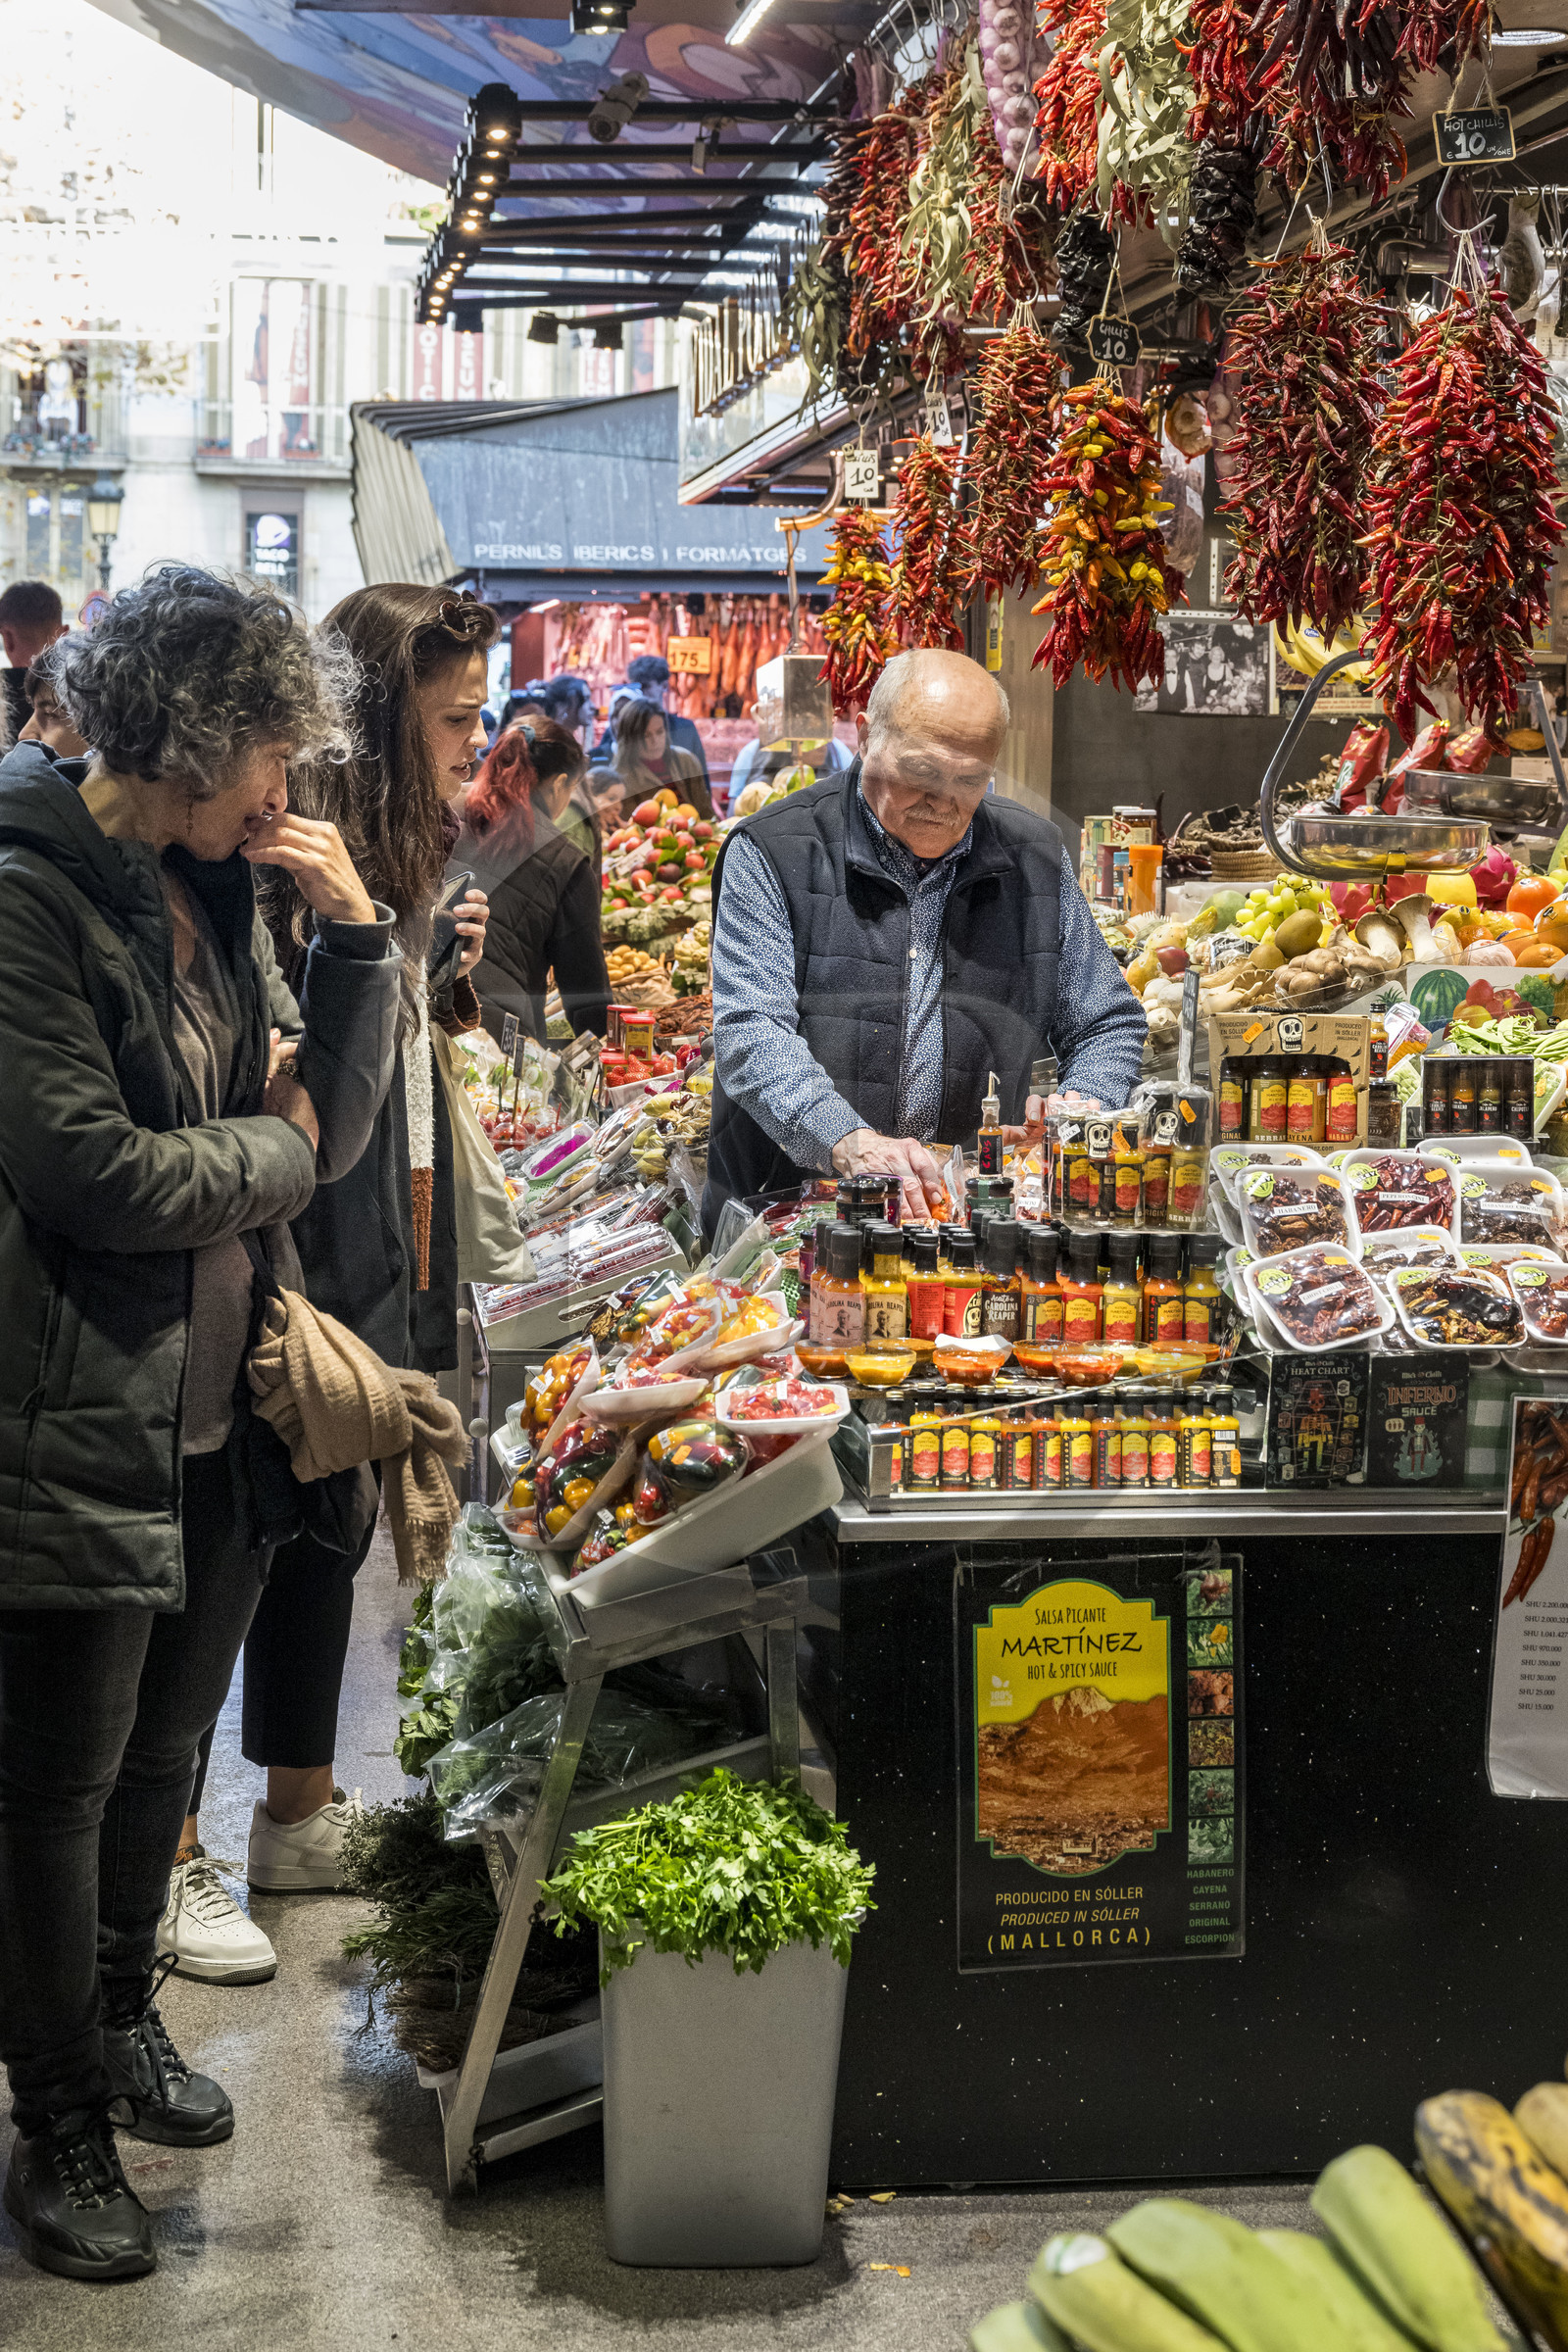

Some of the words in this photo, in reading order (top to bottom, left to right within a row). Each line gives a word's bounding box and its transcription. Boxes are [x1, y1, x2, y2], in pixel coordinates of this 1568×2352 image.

[1444, 118, 1467, 132] HOT
[1454, 132, 1487, 159] 10
[1102, 337, 1126, 360] 10
[930, 411, 946, 434] 10
[850, 467, 874, 487] 10
[573, 545, 655, 562] IBERICS
[676, 546, 808, 564] FORMATGES
[1278, 1204, 1316, 1214] HABANERO
[985, 1300, 1018, 1311] CAROLINA
[987, 1311, 1015, 1321] REAPER
[1388, 1385, 1457, 1406] INFERNO
[1401, 1406, 1438, 1417] SAUCE
[1002, 1626, 1143, 1658] MARTÍNEZ
[1028, 1665, 1046, 1680] HOT
[1049, 1663, 1056, 1679] &
[1060, 1663, 1088, 1679] SPICY
[1089, 1662, 1117, 1678] SAUCE
[1187, 1869, 1235, 1879] HABANERO
[996, 1890, 1069, 1905] PRODUCIDO
[1074, 1889, 1091, 1902] EN
[1095, 1886, 1144, 1901] SÓLLER
[1193, 1885, 1228, 1894] CAYENA
[1189, 1900, 1231, 1910] SERRANO
[1001, 1911, 1070, 1927] PRODUCED
[1073, 1910, 1087, 1923] IN
[1091, 1907, 1140, 1922] SÓLLER
[1189, 1917, 1231, 1928] ORIGINAL
